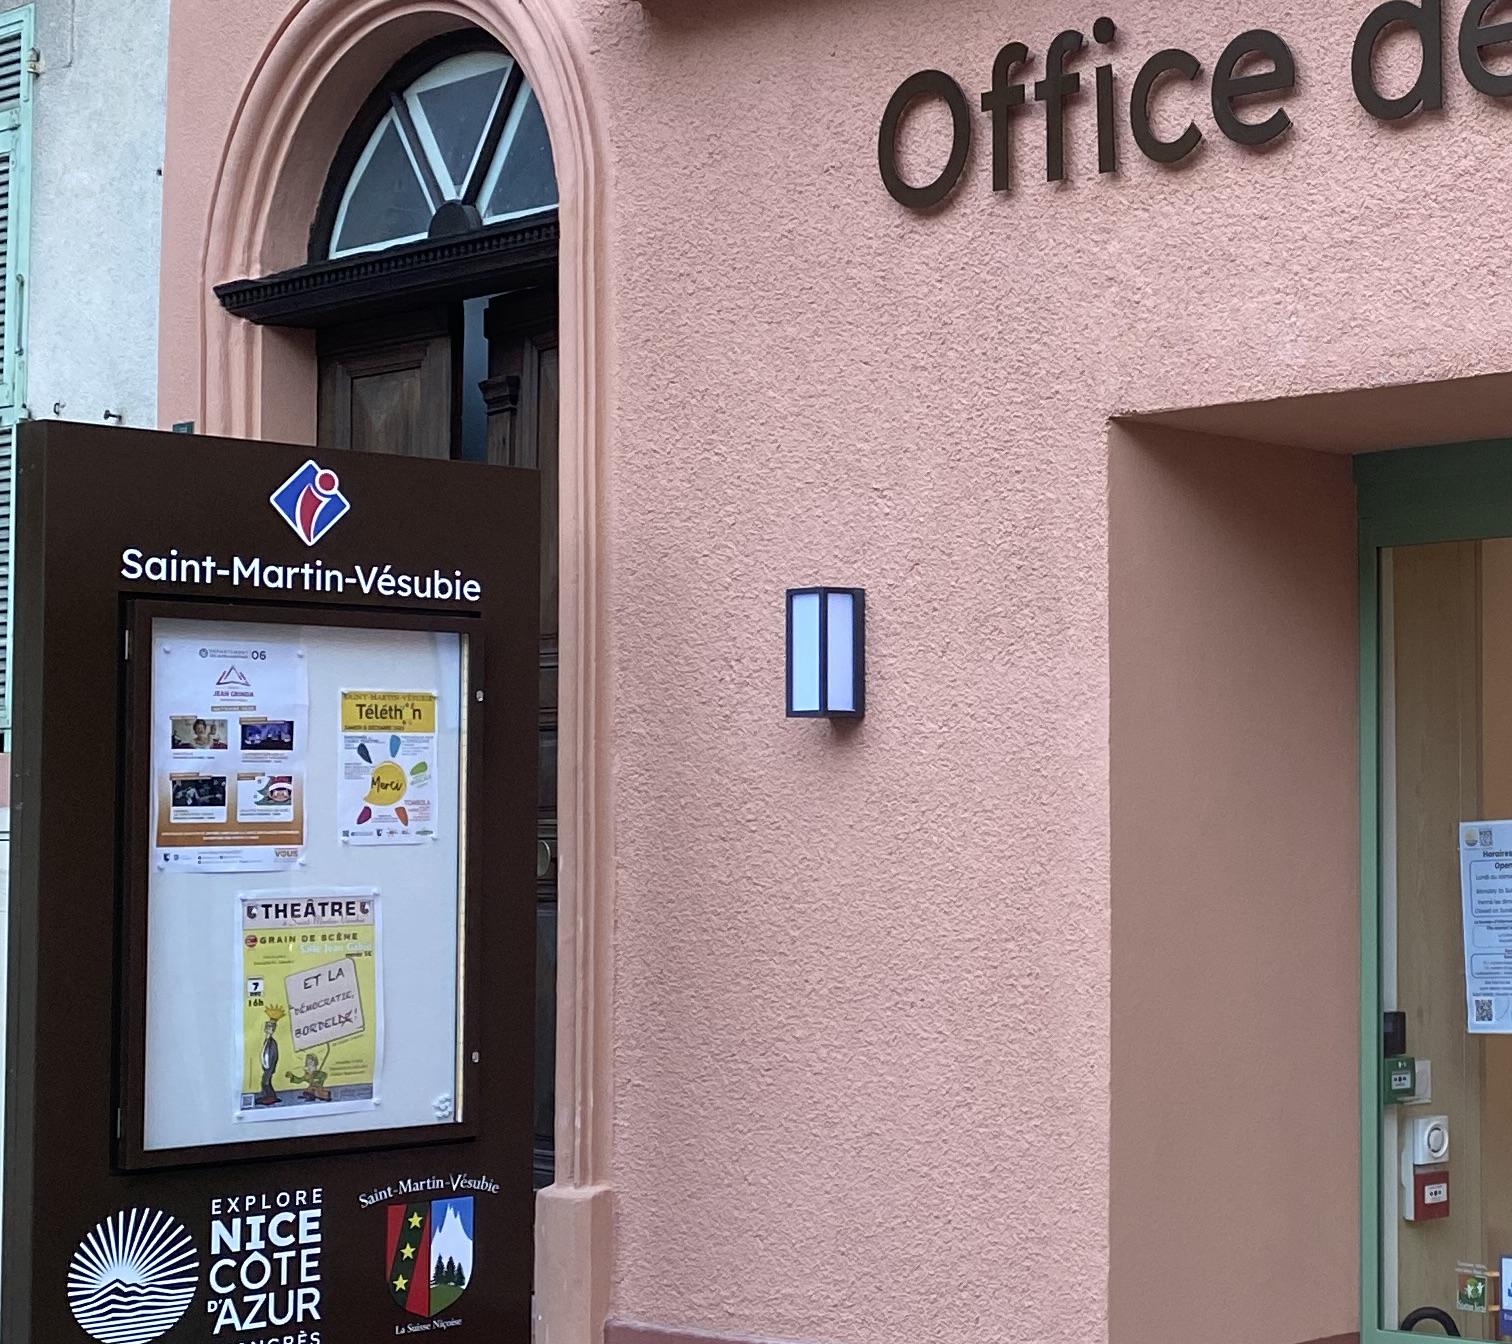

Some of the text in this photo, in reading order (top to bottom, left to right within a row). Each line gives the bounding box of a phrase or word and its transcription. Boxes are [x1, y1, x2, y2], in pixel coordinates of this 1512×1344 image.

[878, 16, 1294, 209] Office
[121, 549, 481, 601] Saint-Martin-Vésubie
[251, 650, 267, 660] 06
[371, 776, 402, 792] Merci
[1483, 849, 1512, 857] Horaires
[260, 936, 296, 944] GRAIN
[252, 982, 259, 991] 7
[303, 968, 344, 989] ET LA
[211, 1188, 323, 1214] EXPLORE
[359, 1173, 500, 1208] Saint-Martin-Vésubie
[211, 1209, 322, 1255] NICE
[209, 1250, 321, 1294] CÔTE
[207, 1287, 321, 1335] D'AZUR
[395, 1325, 406, 1335] La
